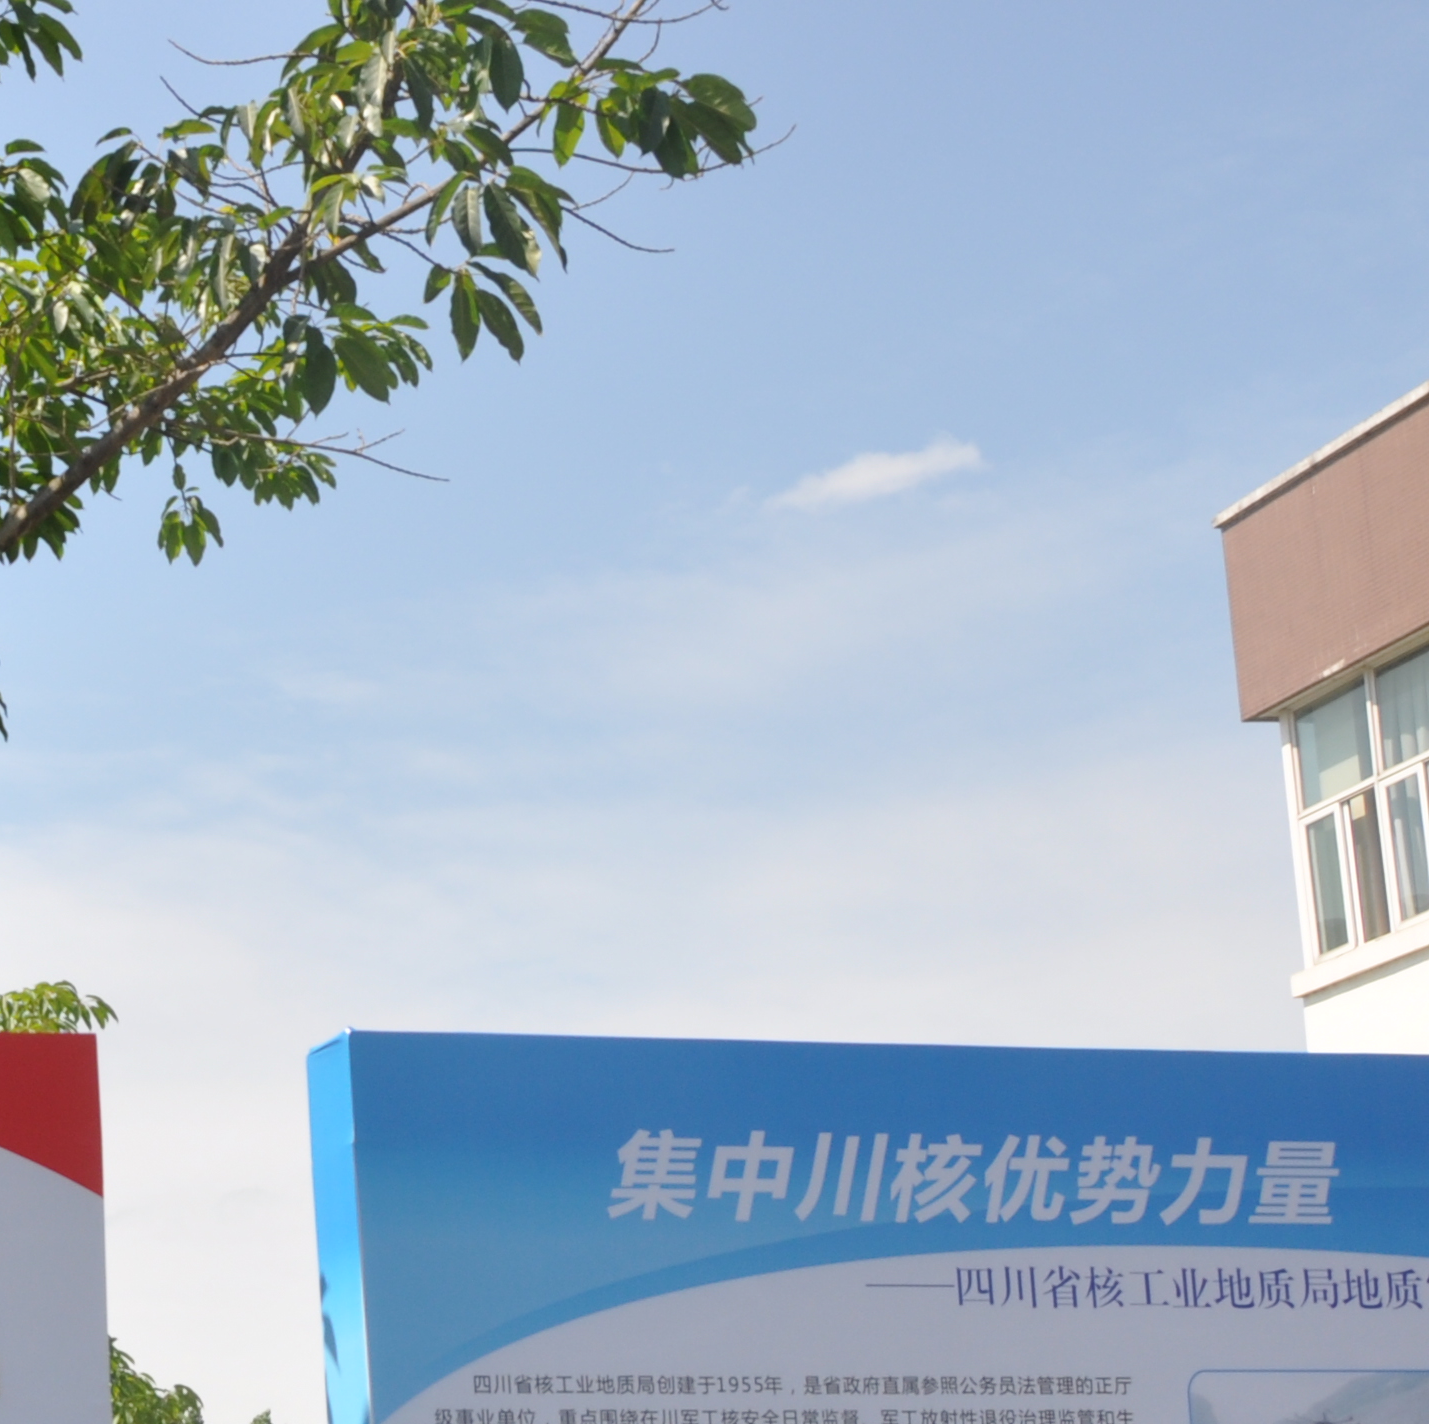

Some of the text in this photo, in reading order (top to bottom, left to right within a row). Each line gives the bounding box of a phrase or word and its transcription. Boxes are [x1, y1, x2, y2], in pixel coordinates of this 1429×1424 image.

[605, 1128, 1341, 1228] 集中川核优势力量
